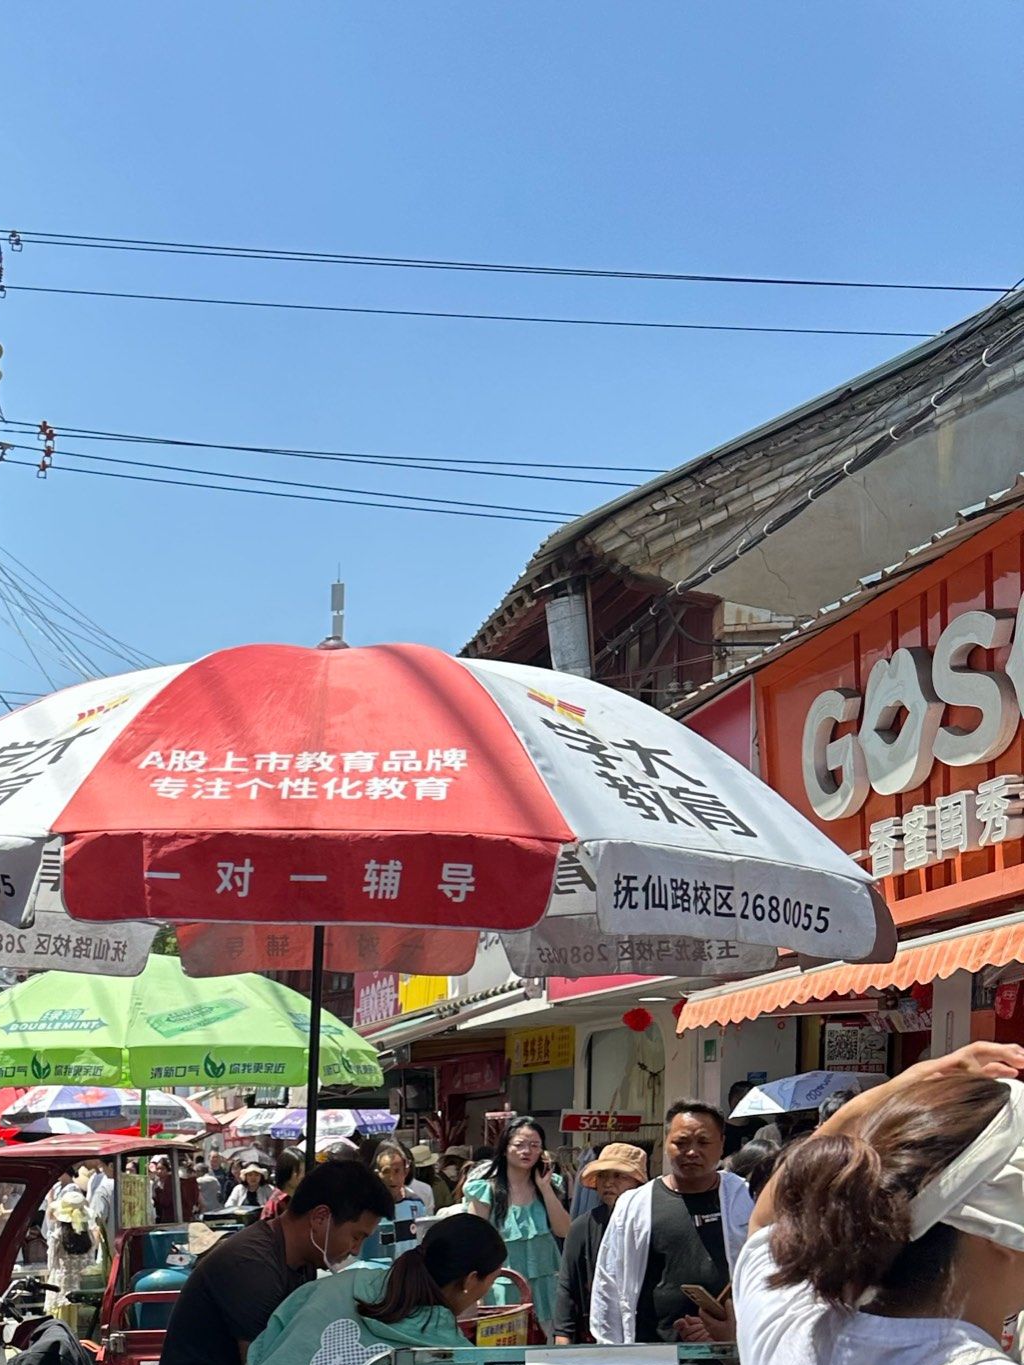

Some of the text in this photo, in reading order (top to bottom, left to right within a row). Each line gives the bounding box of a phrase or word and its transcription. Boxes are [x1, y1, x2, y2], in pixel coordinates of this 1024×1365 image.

[803, 594, 1023, 821] GOS
[138, 748, 469, 773] A股上市教育品牌
[539, 716, 707, 788] 学大
[149, 776, 454, 800] 专注个性化教育
[595, 769, 758, 838] 教育
[9, 1020, 98, 1032] DOUBLEMINT
[150, 1065, 201, 1080] 清新口气
